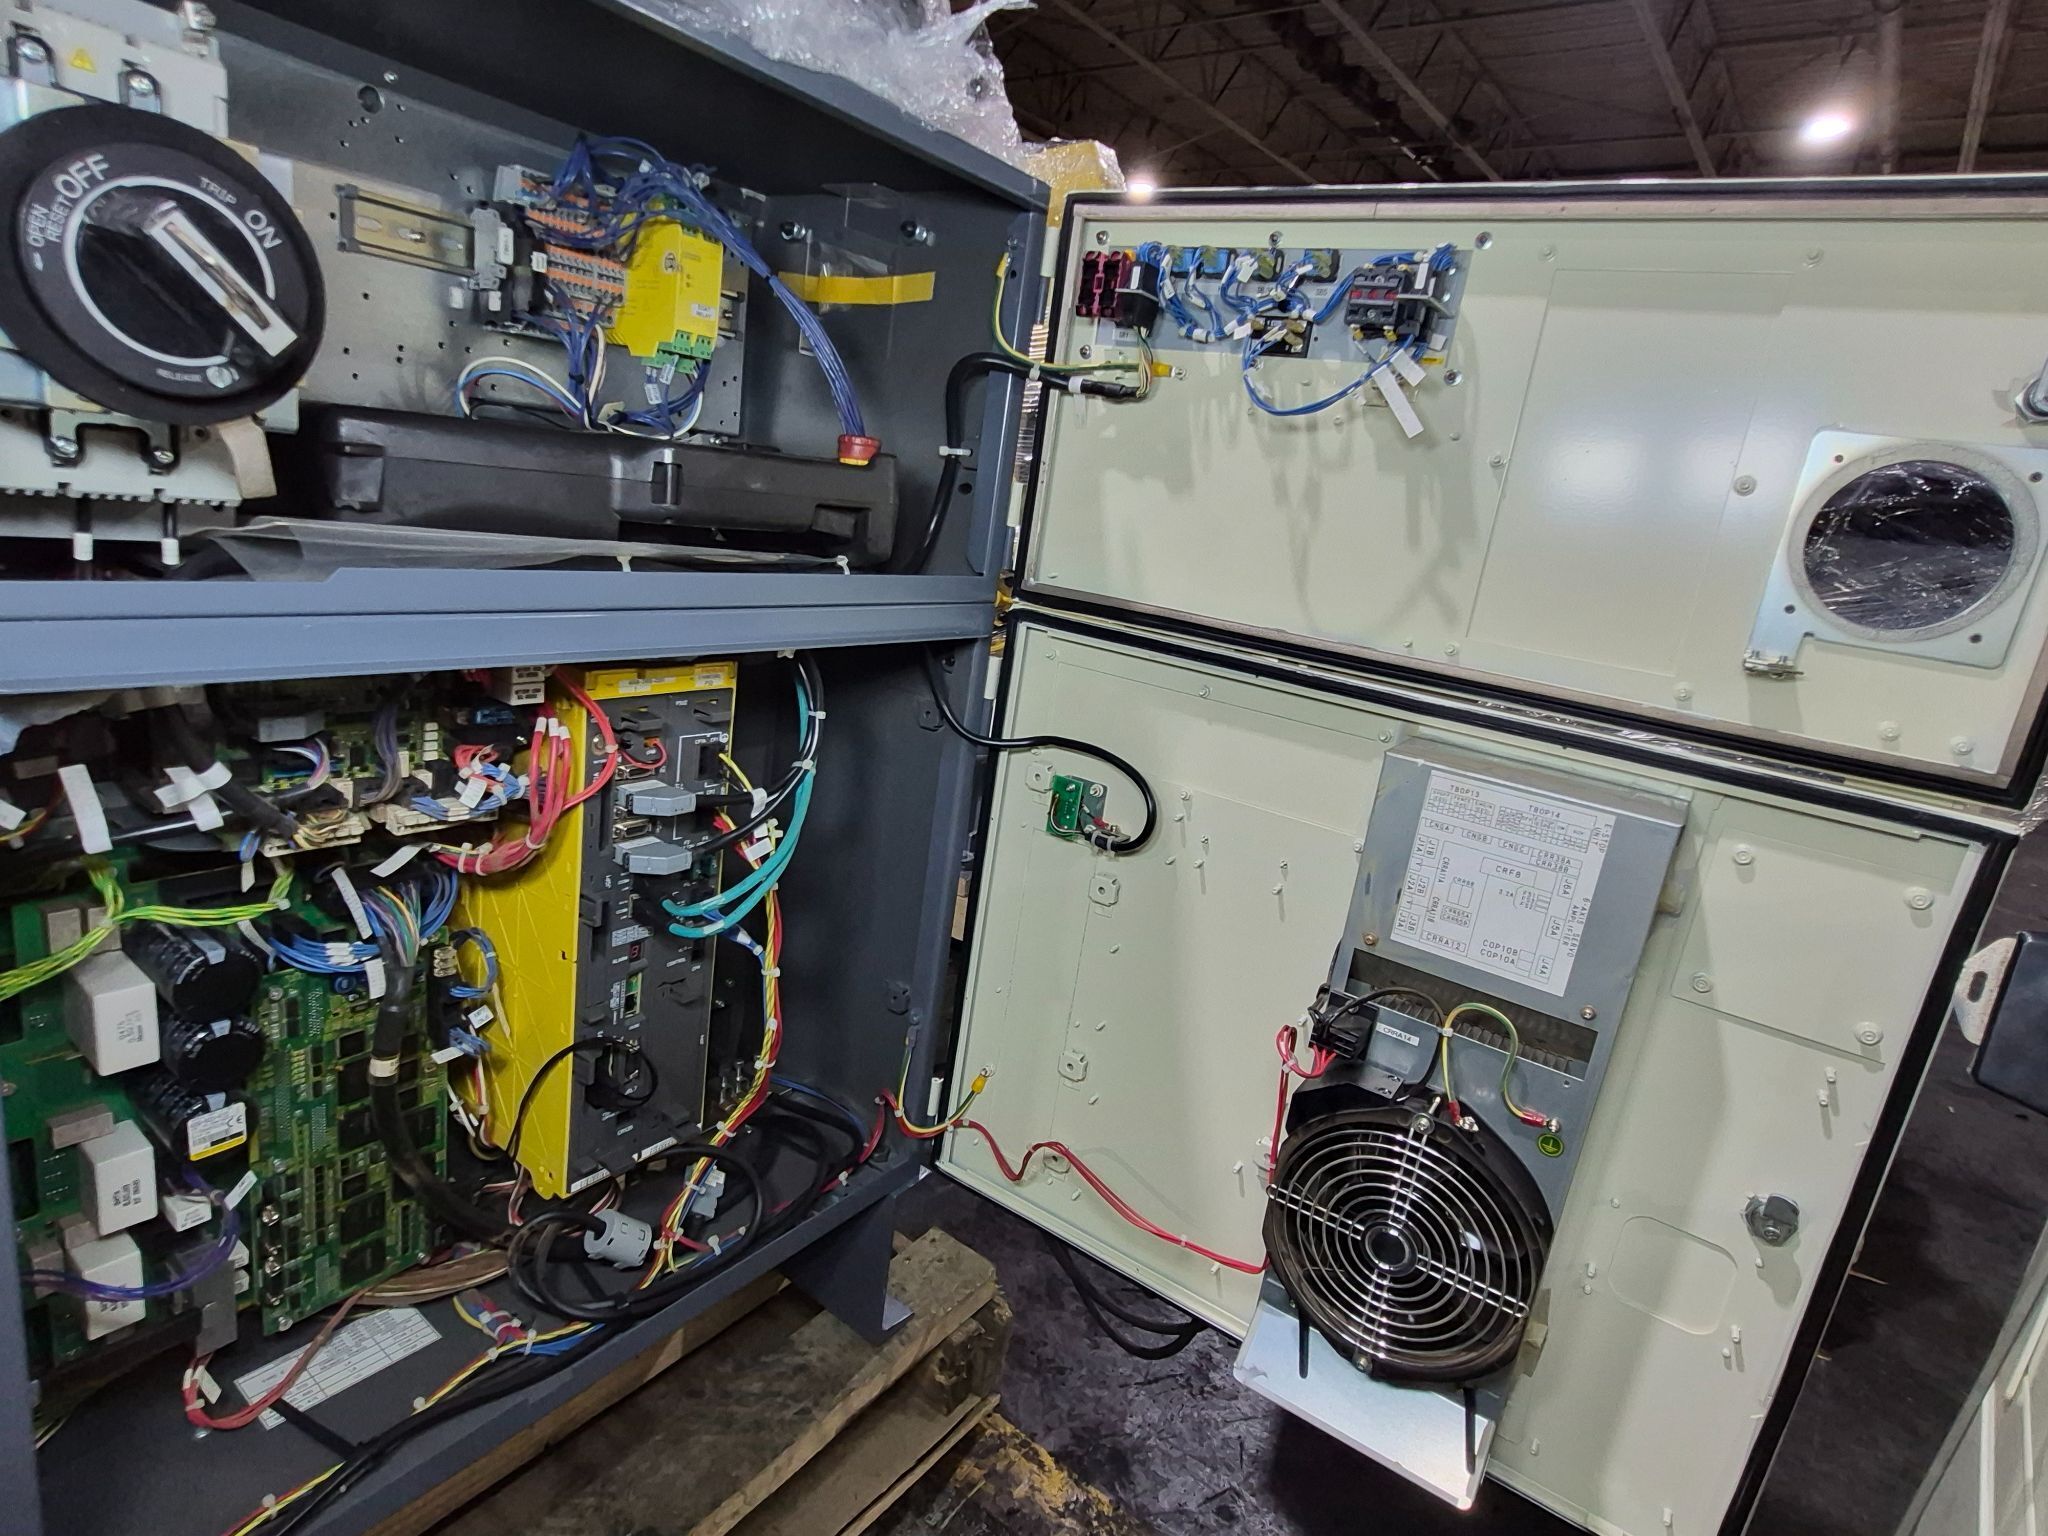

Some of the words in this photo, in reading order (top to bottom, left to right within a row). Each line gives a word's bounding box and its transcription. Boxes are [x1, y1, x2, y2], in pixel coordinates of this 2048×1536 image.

[53, 154, 110, 198] OFF
[199, 176, 238, 205] TRIP
[26, 203, 49, 247] OPEN
[46, 195, 73, 243] RESET
[244, 208, 283, 250] ON
[1450, 784, 1480, 798] TBOP13
[1529, 804, 1561, 819] TBOP14
[1415, 836, 1426, 853] J1A
[1591, 827, 1602, 846] UNIT
[1598, 823, 1613, 854] E-STOP
[1426, 839, 1436, 856] J1B
[1495, 865, 1522, 879] CRF8
[1406, 874, 1416, 891] J2A
[1416, 877, 1426, 895] J2B
[1562, 878, 1573, 896] J6A
[1397, 911, 1406, 928] J3A
[1576, 897, 1591, 924] 6-AXIS
[1549, 919, 1561, 937] J5A
[1562, 904, 1579, 947] AMPLIFIER
[1426, 932, 1462, 951] CRRA12
[1566, 933, 1580, 958] SERVO
[1539, 958, 1549, 975] J4A
[1383, 1027, 1412, 1042] CRRA14
